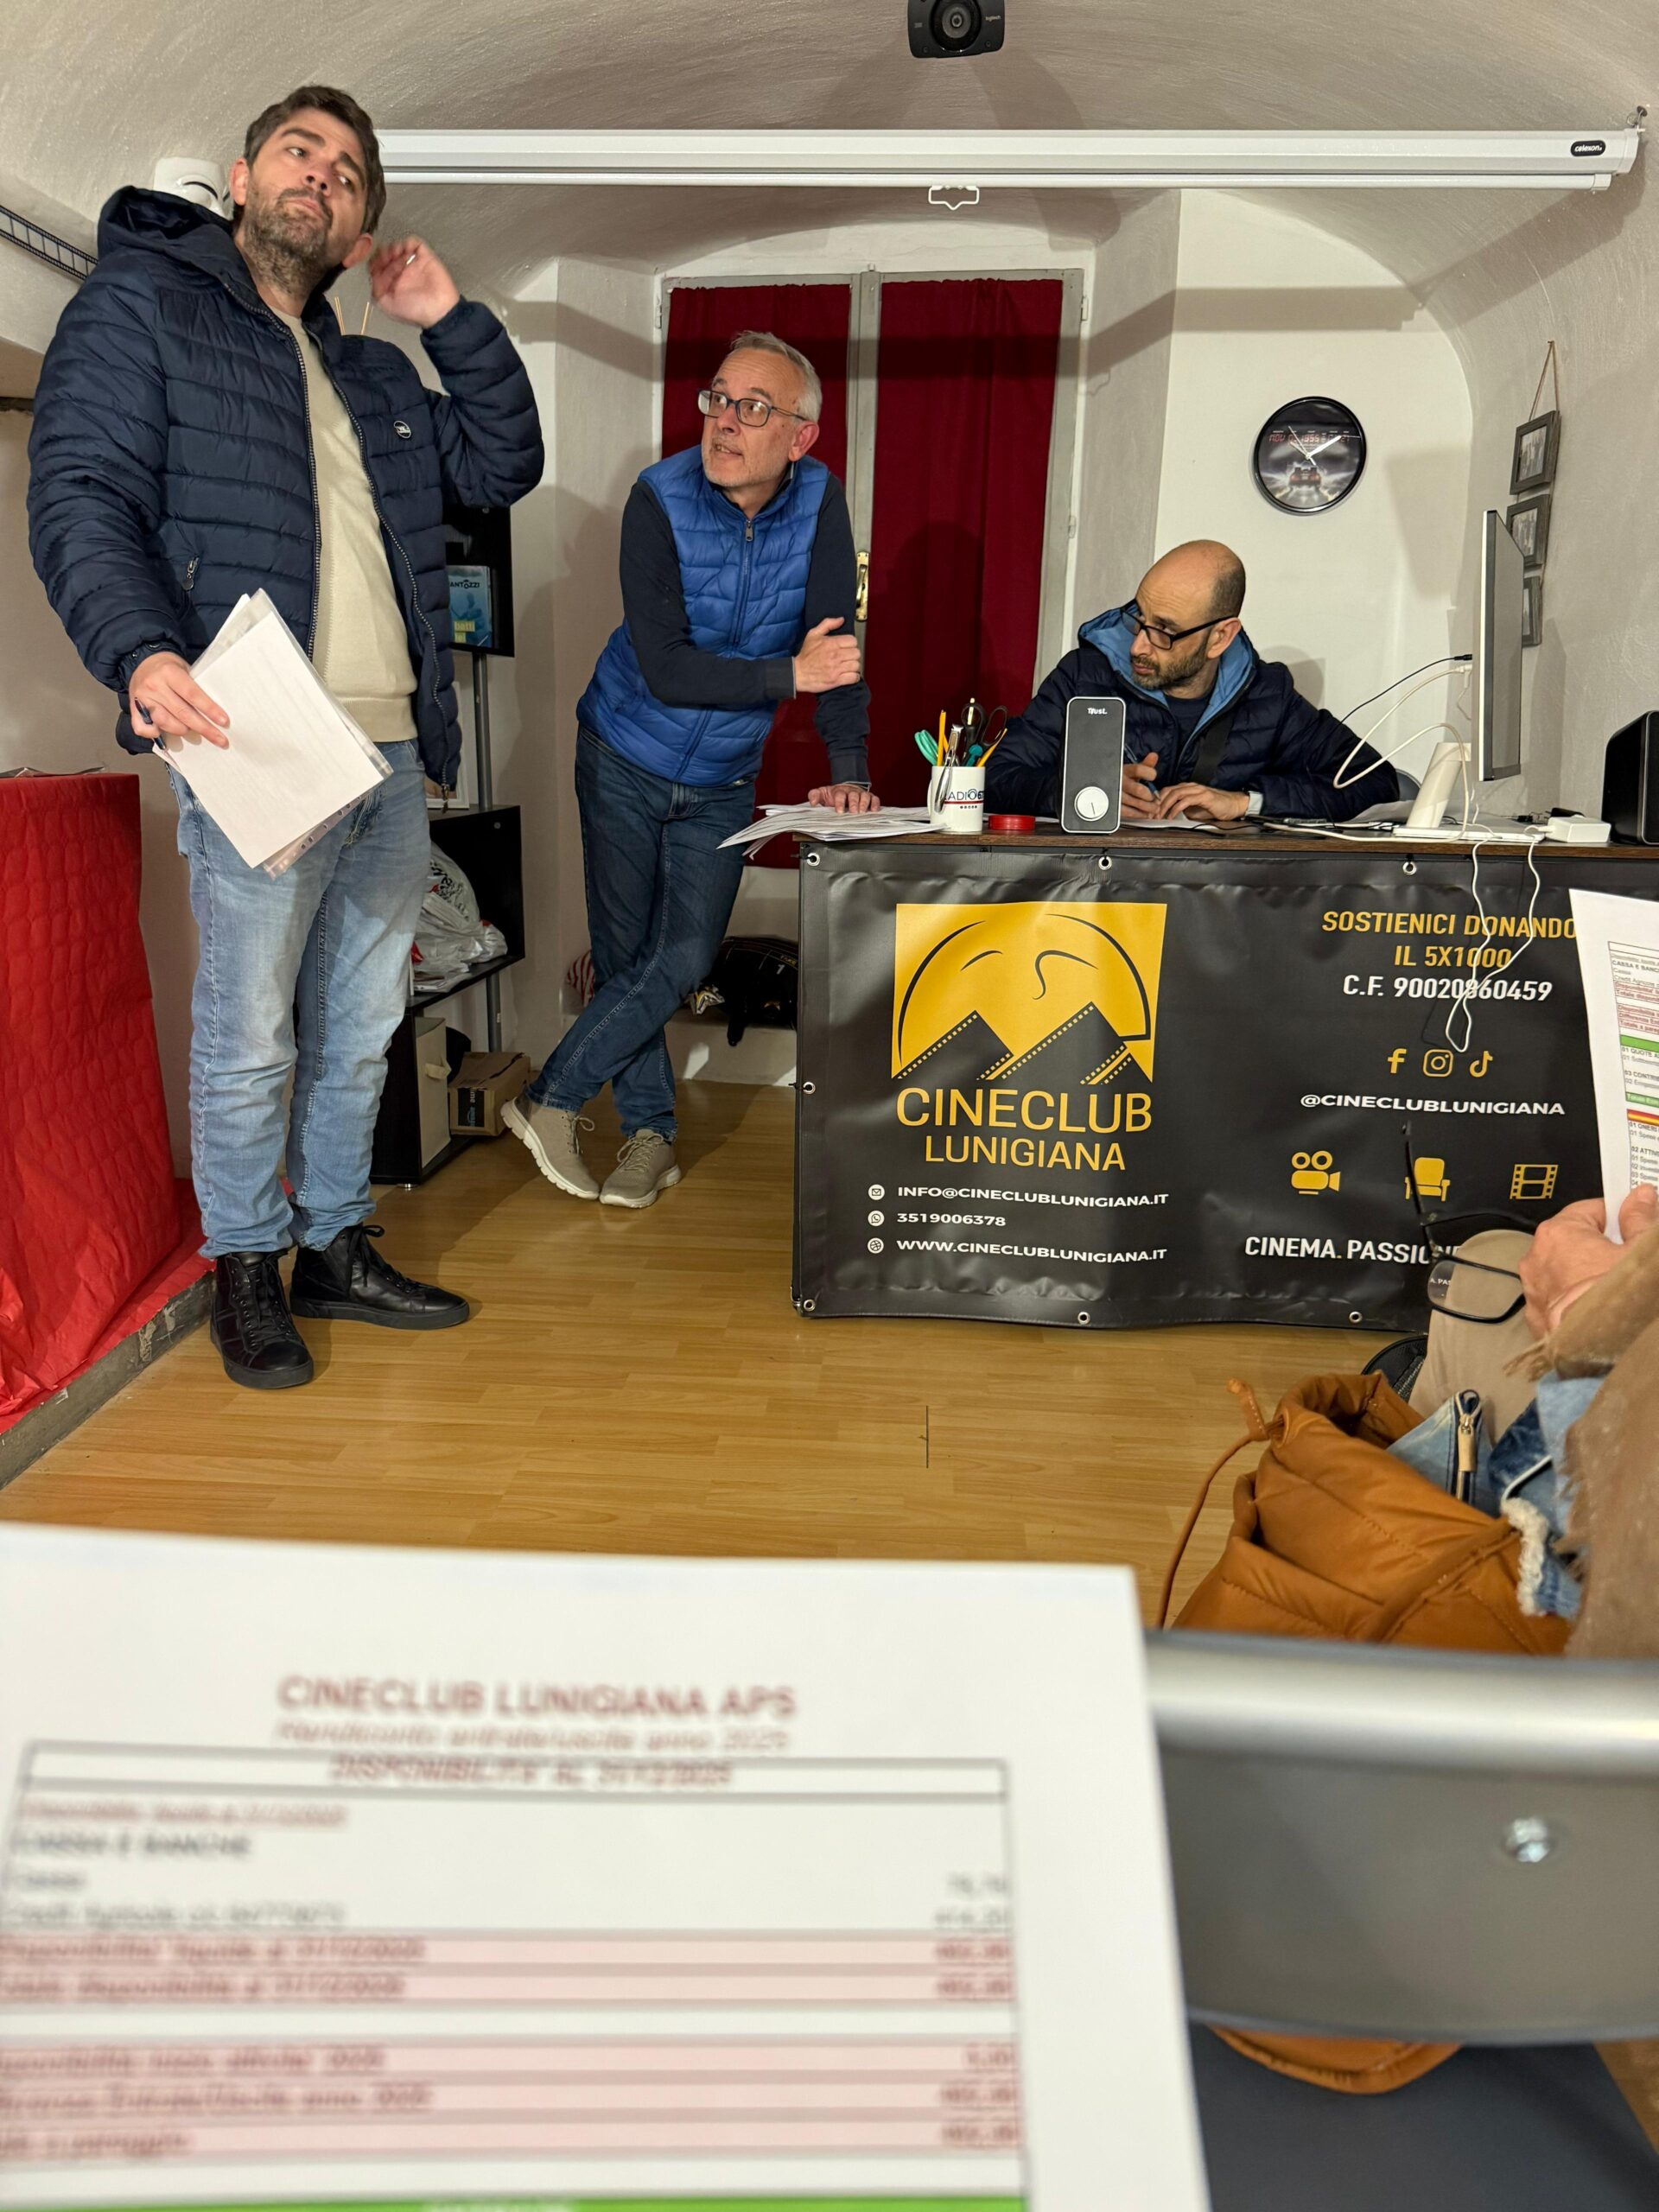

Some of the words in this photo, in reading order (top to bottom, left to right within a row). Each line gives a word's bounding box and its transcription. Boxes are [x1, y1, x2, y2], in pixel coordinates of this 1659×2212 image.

[449, 579, 480, 589] ANTOZZI
[1322, 911, 1456, 935] SOSTIENICI
[1464, 915, 1577, 939] DONANDO
[1394, 945, 1417, 966] IL
[1424, 946, 1512, 969] 5X1000
[1343, 974, 1384, 996] C.F.
[896, 1087, 1153, 1134] CINECLUB
[1300, 1094, 1566, 1116] @CINECLUBLUNIGIANA
[925, 1135, 1126, 1171] LUNIGIANA
[897, 1186, 1169, 1208] INFO@CINECLUBLUNIGIANA.IT
[897, 1212, 1006, 1227] 3519006378
[896, 1239, 1167, 1264] WWW.CINECLUBLUNIGIANA.IT
[1245, 1236, 1342, 1259] CINEMA.
[276, 1675, 486, 1714] CINECLUB
[496, 1680, 709, 1717] LUNIGIANA
[720, 1683, 797, 1718] APS
